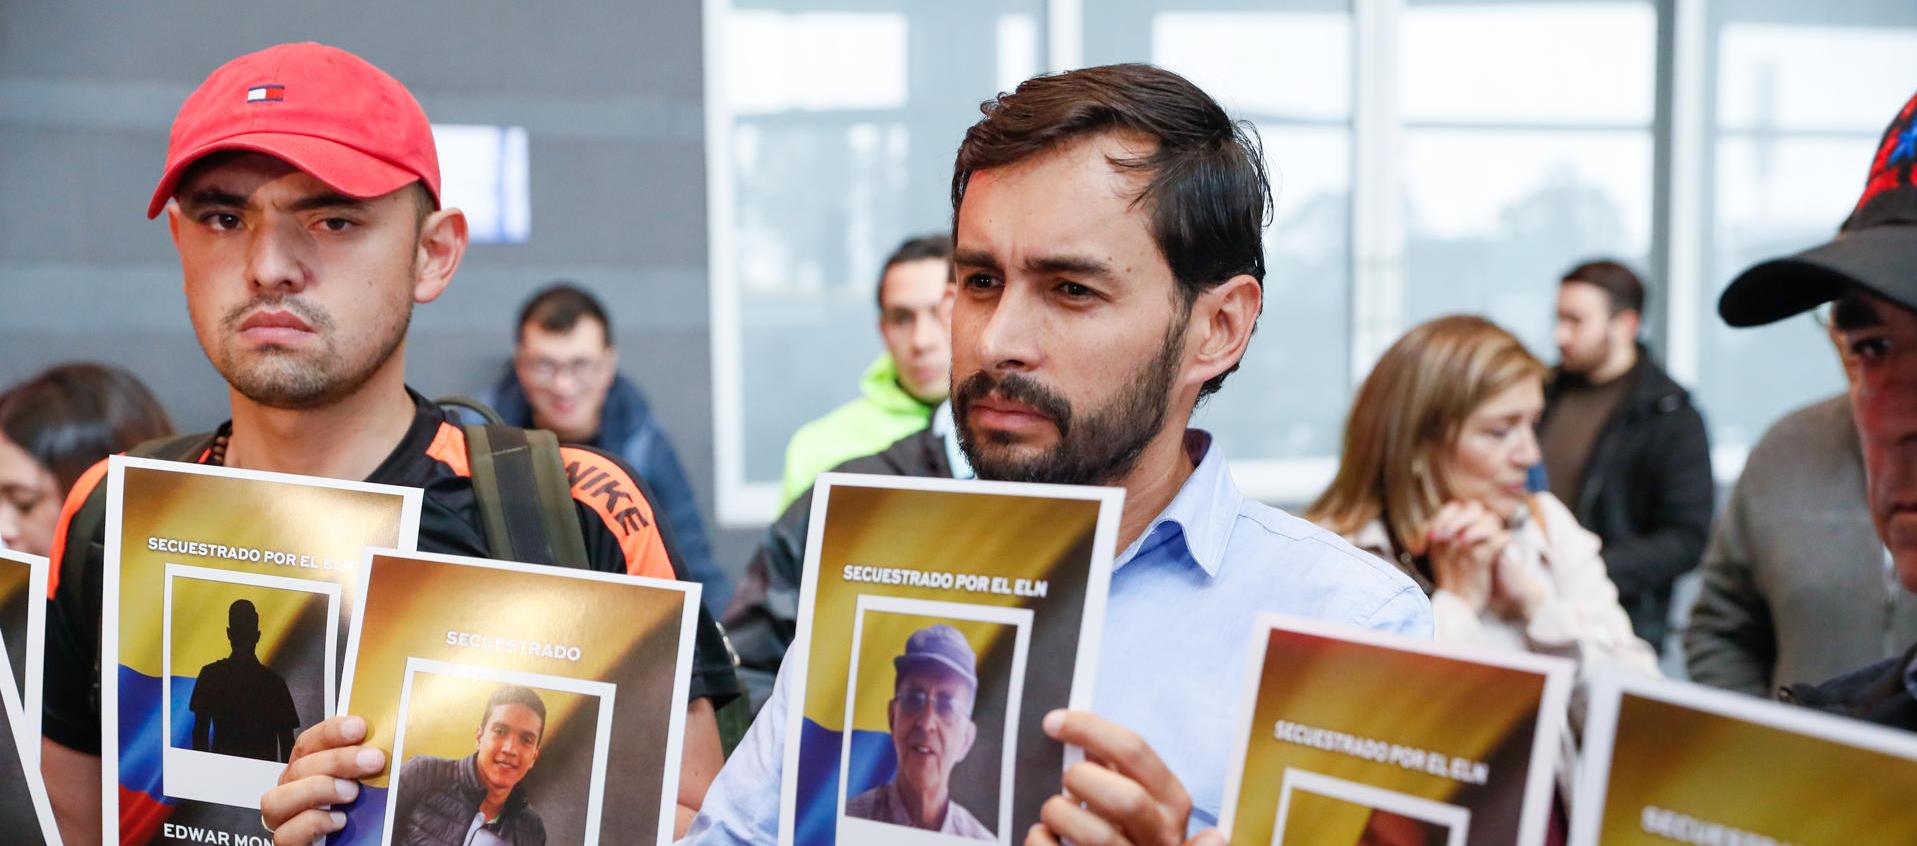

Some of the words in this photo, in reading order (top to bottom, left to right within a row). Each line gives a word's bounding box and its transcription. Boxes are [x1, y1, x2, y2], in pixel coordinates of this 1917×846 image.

[564, 461, 650, 536] NIKE
[148, 537, 260, 562] SECUESTRADO
[263, 551, 296, 566] POR
[300, 555, 319, 569] EL
[843, 564, 954, 589] SECUESTRADO
[955, 573, 990, 592] POR
[992, 577, 1011, 595] EL
[1014, 578, 1048, 597] ELN
[446, 631, 582, 661] SECUESTRADO
[1274, 719, 1388, 762] SECUESTRADO
[1388, 743, 1425, 772] POR
[163, 822, 230, 846] EDWAR
